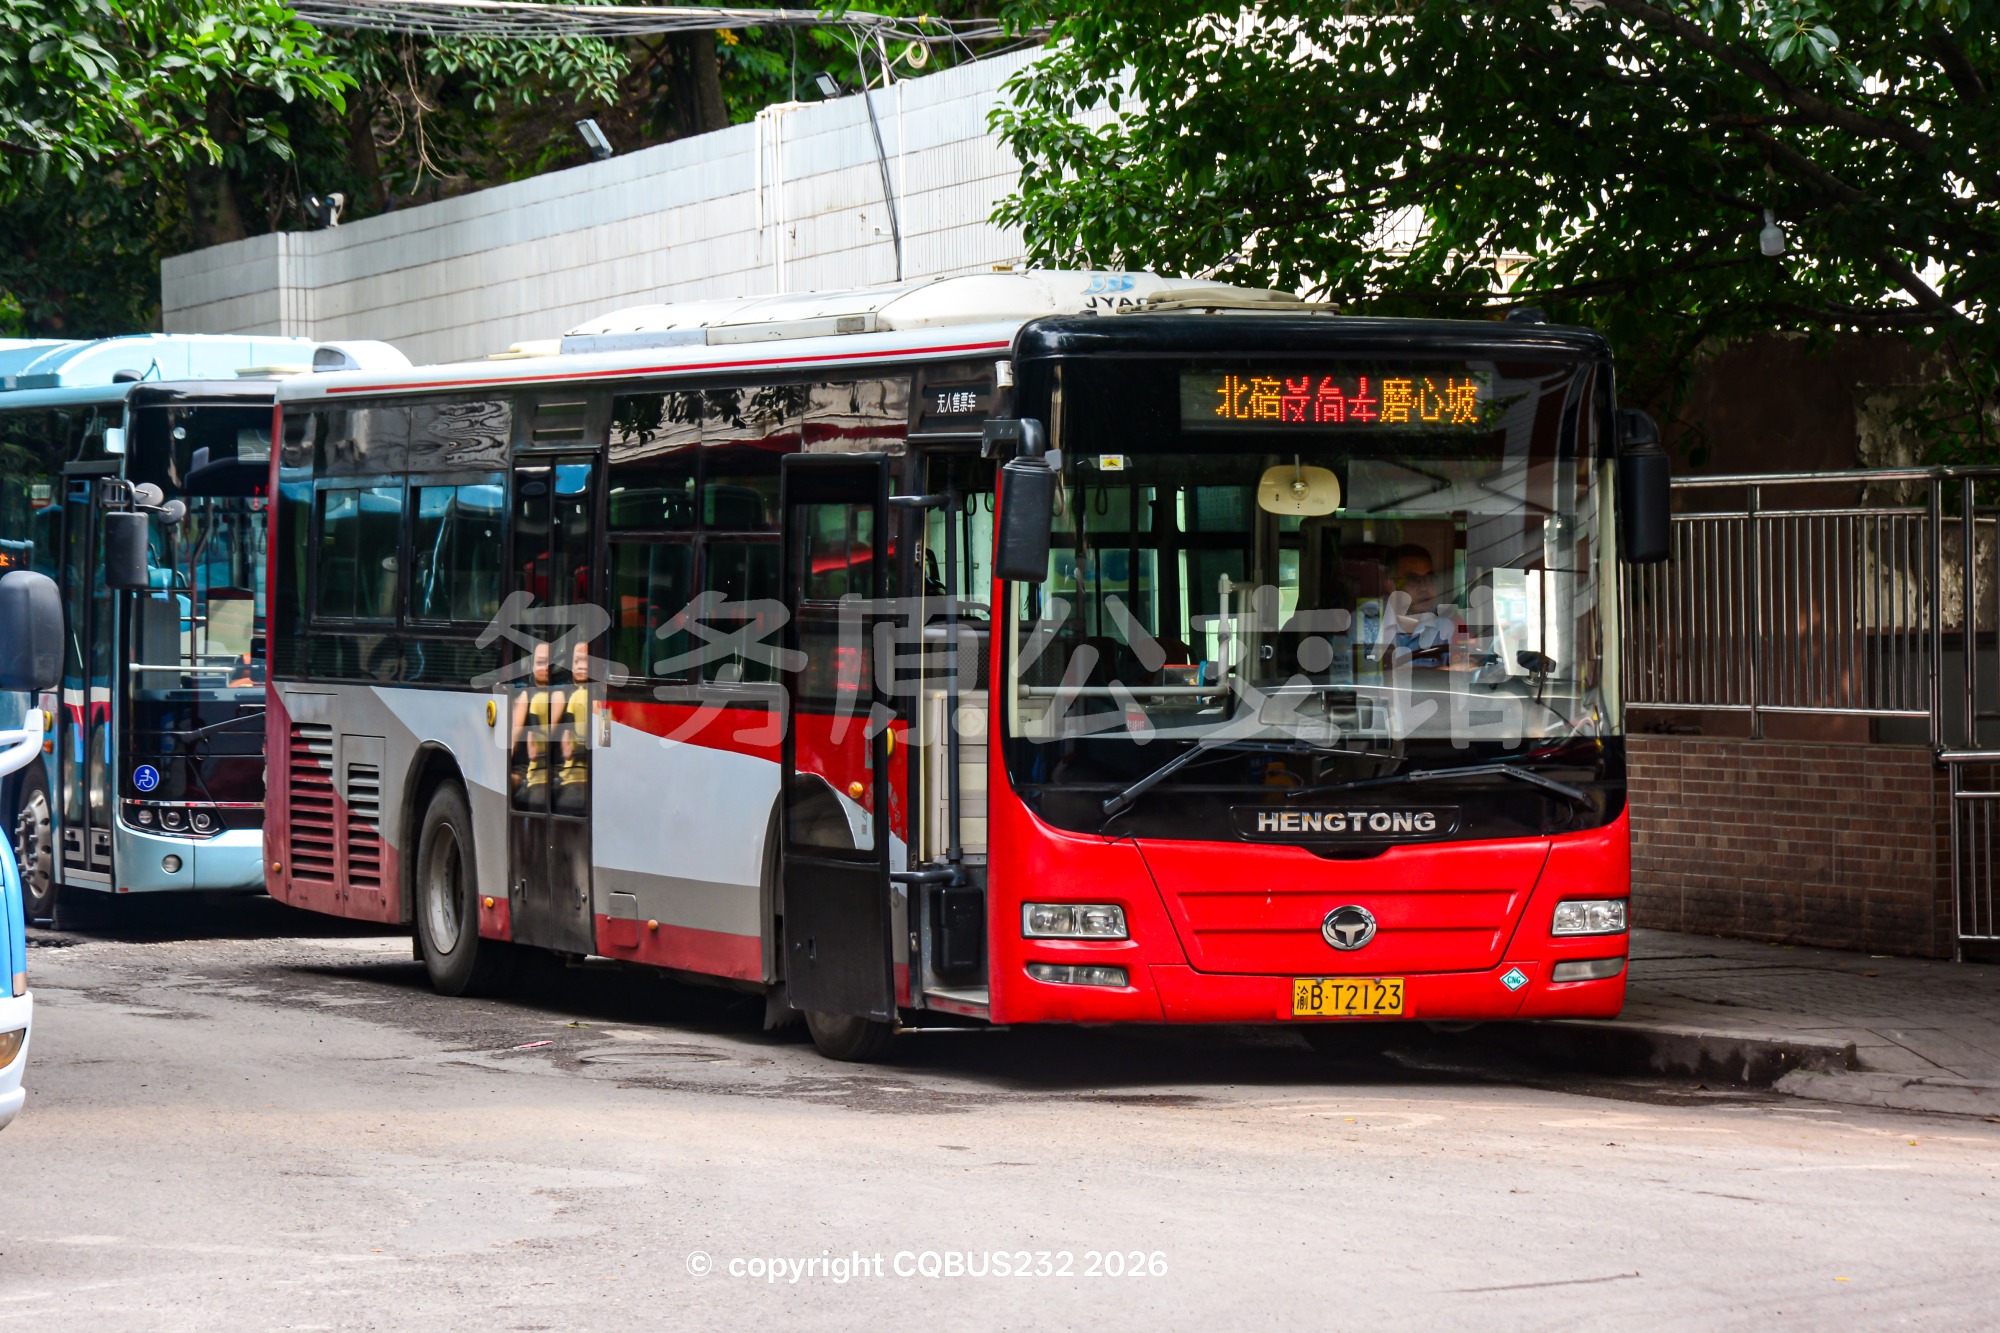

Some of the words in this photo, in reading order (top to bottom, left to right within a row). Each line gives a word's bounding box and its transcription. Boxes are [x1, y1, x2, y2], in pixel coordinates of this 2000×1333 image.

[936, 391, 977, 414] 无人售票车
[1257, 811, 1437, 832] HENGTONG
[1506, 975, 1521, 985] CNG
